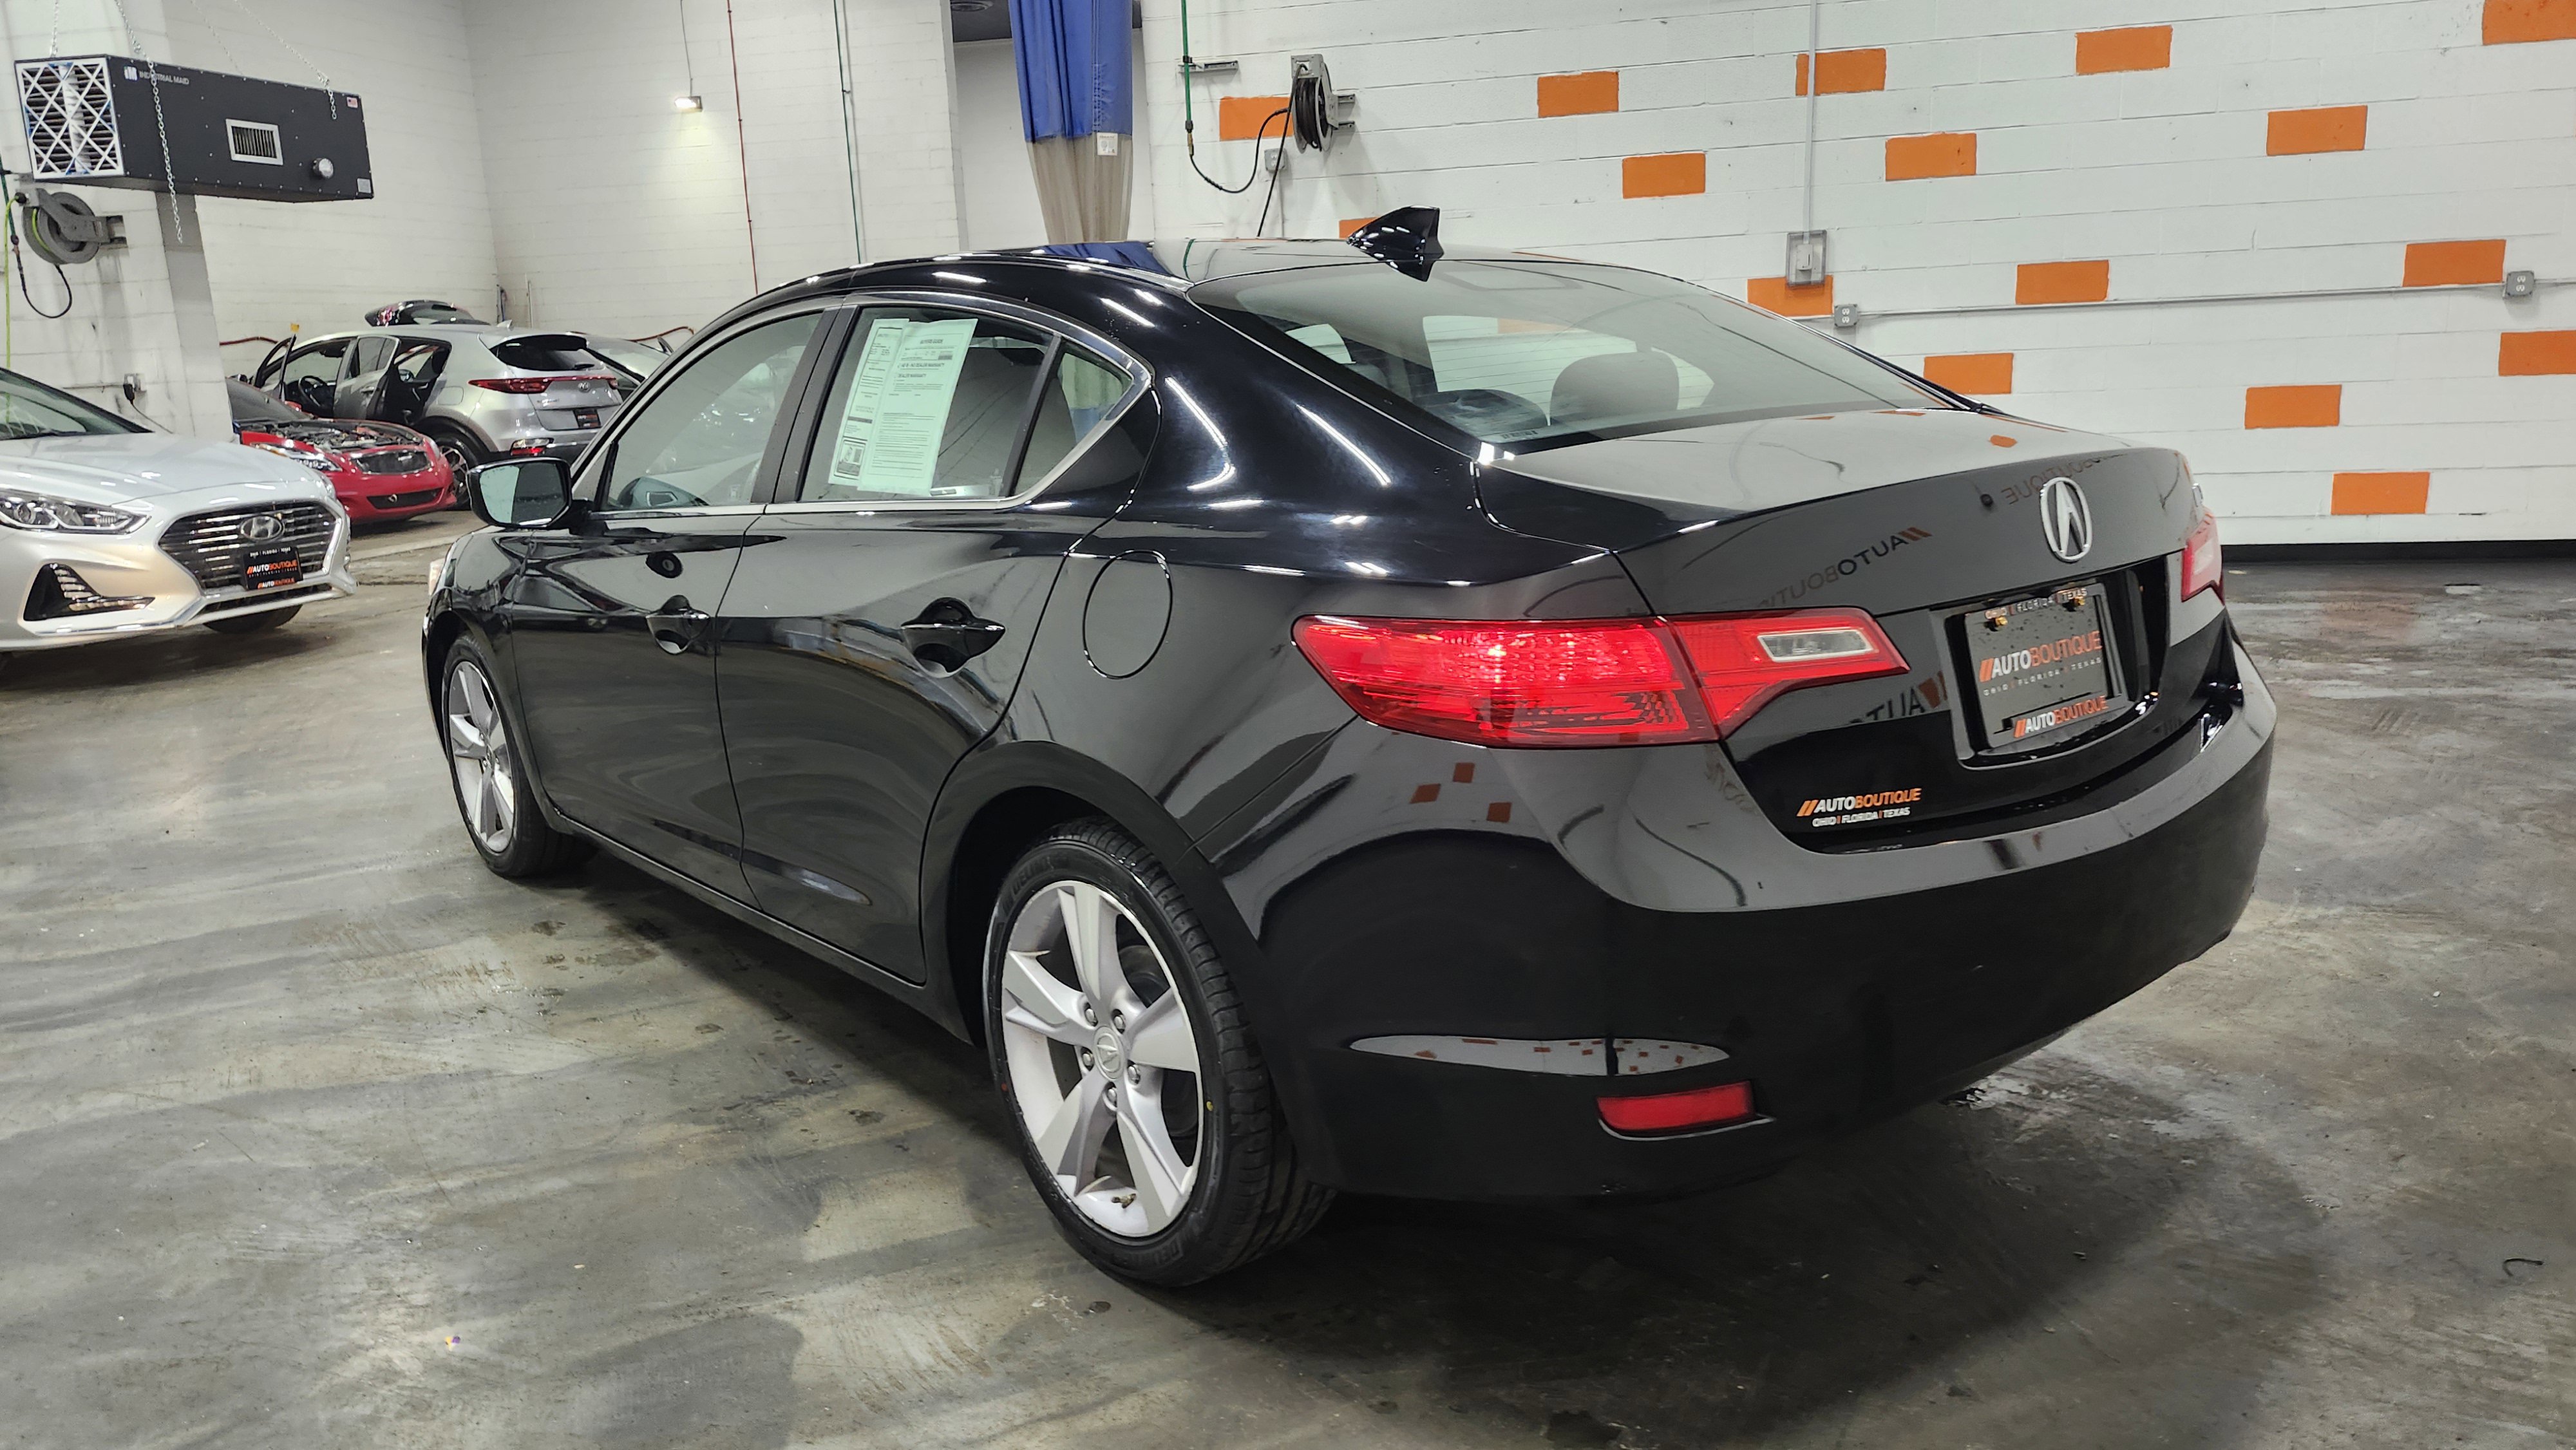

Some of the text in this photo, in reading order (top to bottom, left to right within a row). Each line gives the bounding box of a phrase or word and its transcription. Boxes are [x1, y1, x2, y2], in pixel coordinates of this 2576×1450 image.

[1991, 630, 2103, 679] AUTOBOUTIQUE
[2018, 669, 2060, 686] FLORIDA
[2071, 657, 2102, 671] TEXAS
[2025, 695, 2109, 733] AUTOBOUTIQUE
[1814, 787, 1922, 813] AUTOBOUTIQUE
[1841, 811, 1879, 824] FLORIDA
[1884, 807, 1911, 818] TEXAS
